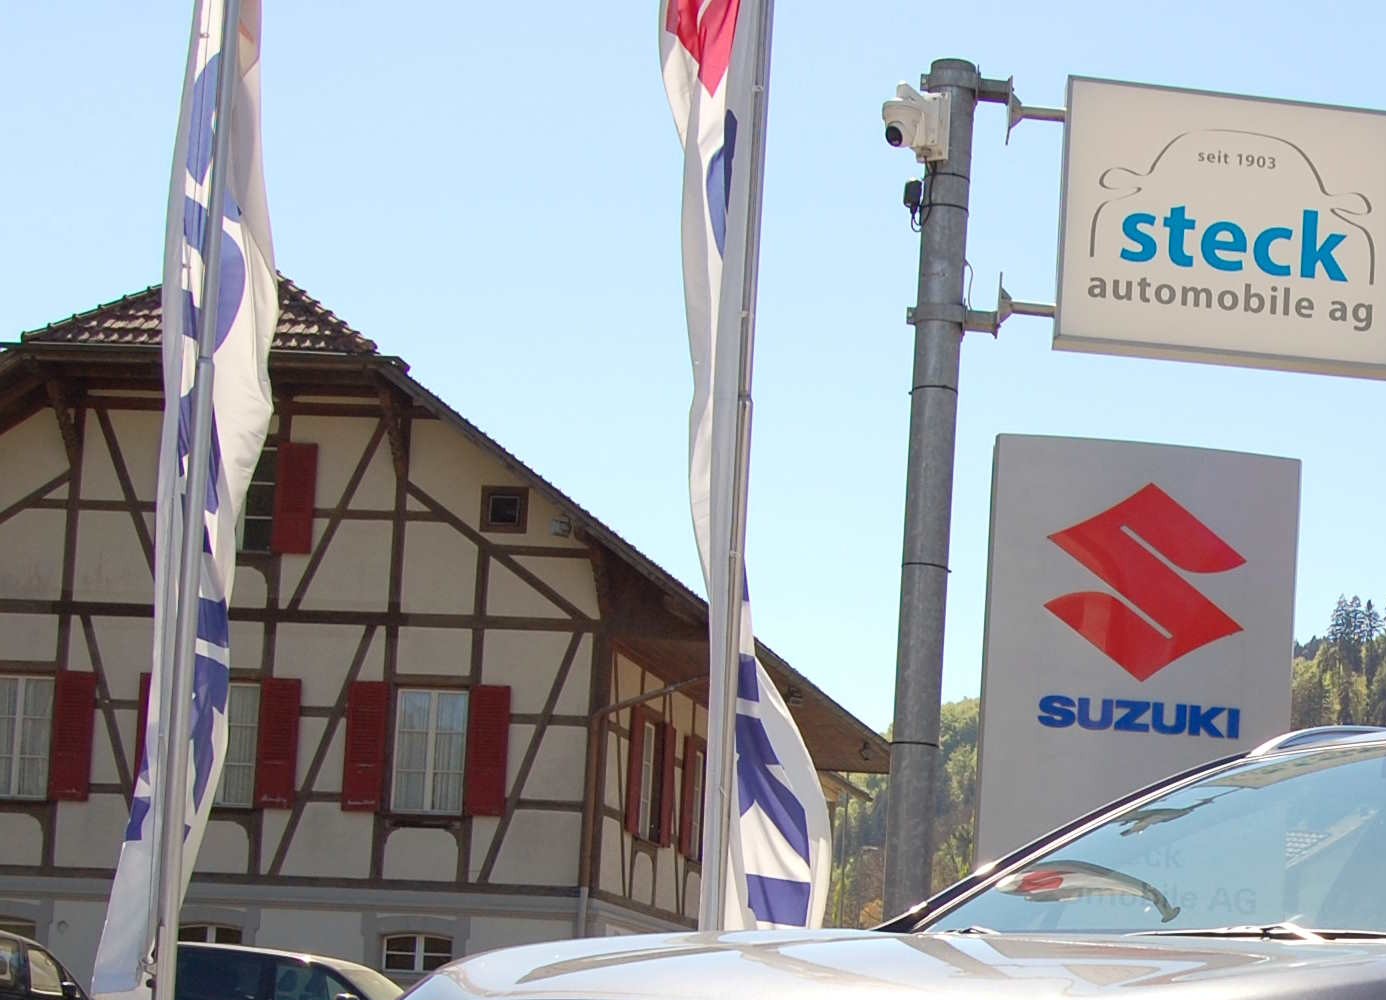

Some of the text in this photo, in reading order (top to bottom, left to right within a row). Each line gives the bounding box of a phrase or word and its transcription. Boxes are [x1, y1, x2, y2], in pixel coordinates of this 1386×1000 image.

[1198, 150, 1277, 170] seit 1903
[1119, 205, 1349, 283] steck
[1087, 276, 1374, 332] automobile ag
[1038, 694, 1241, 740] SUZUKI
